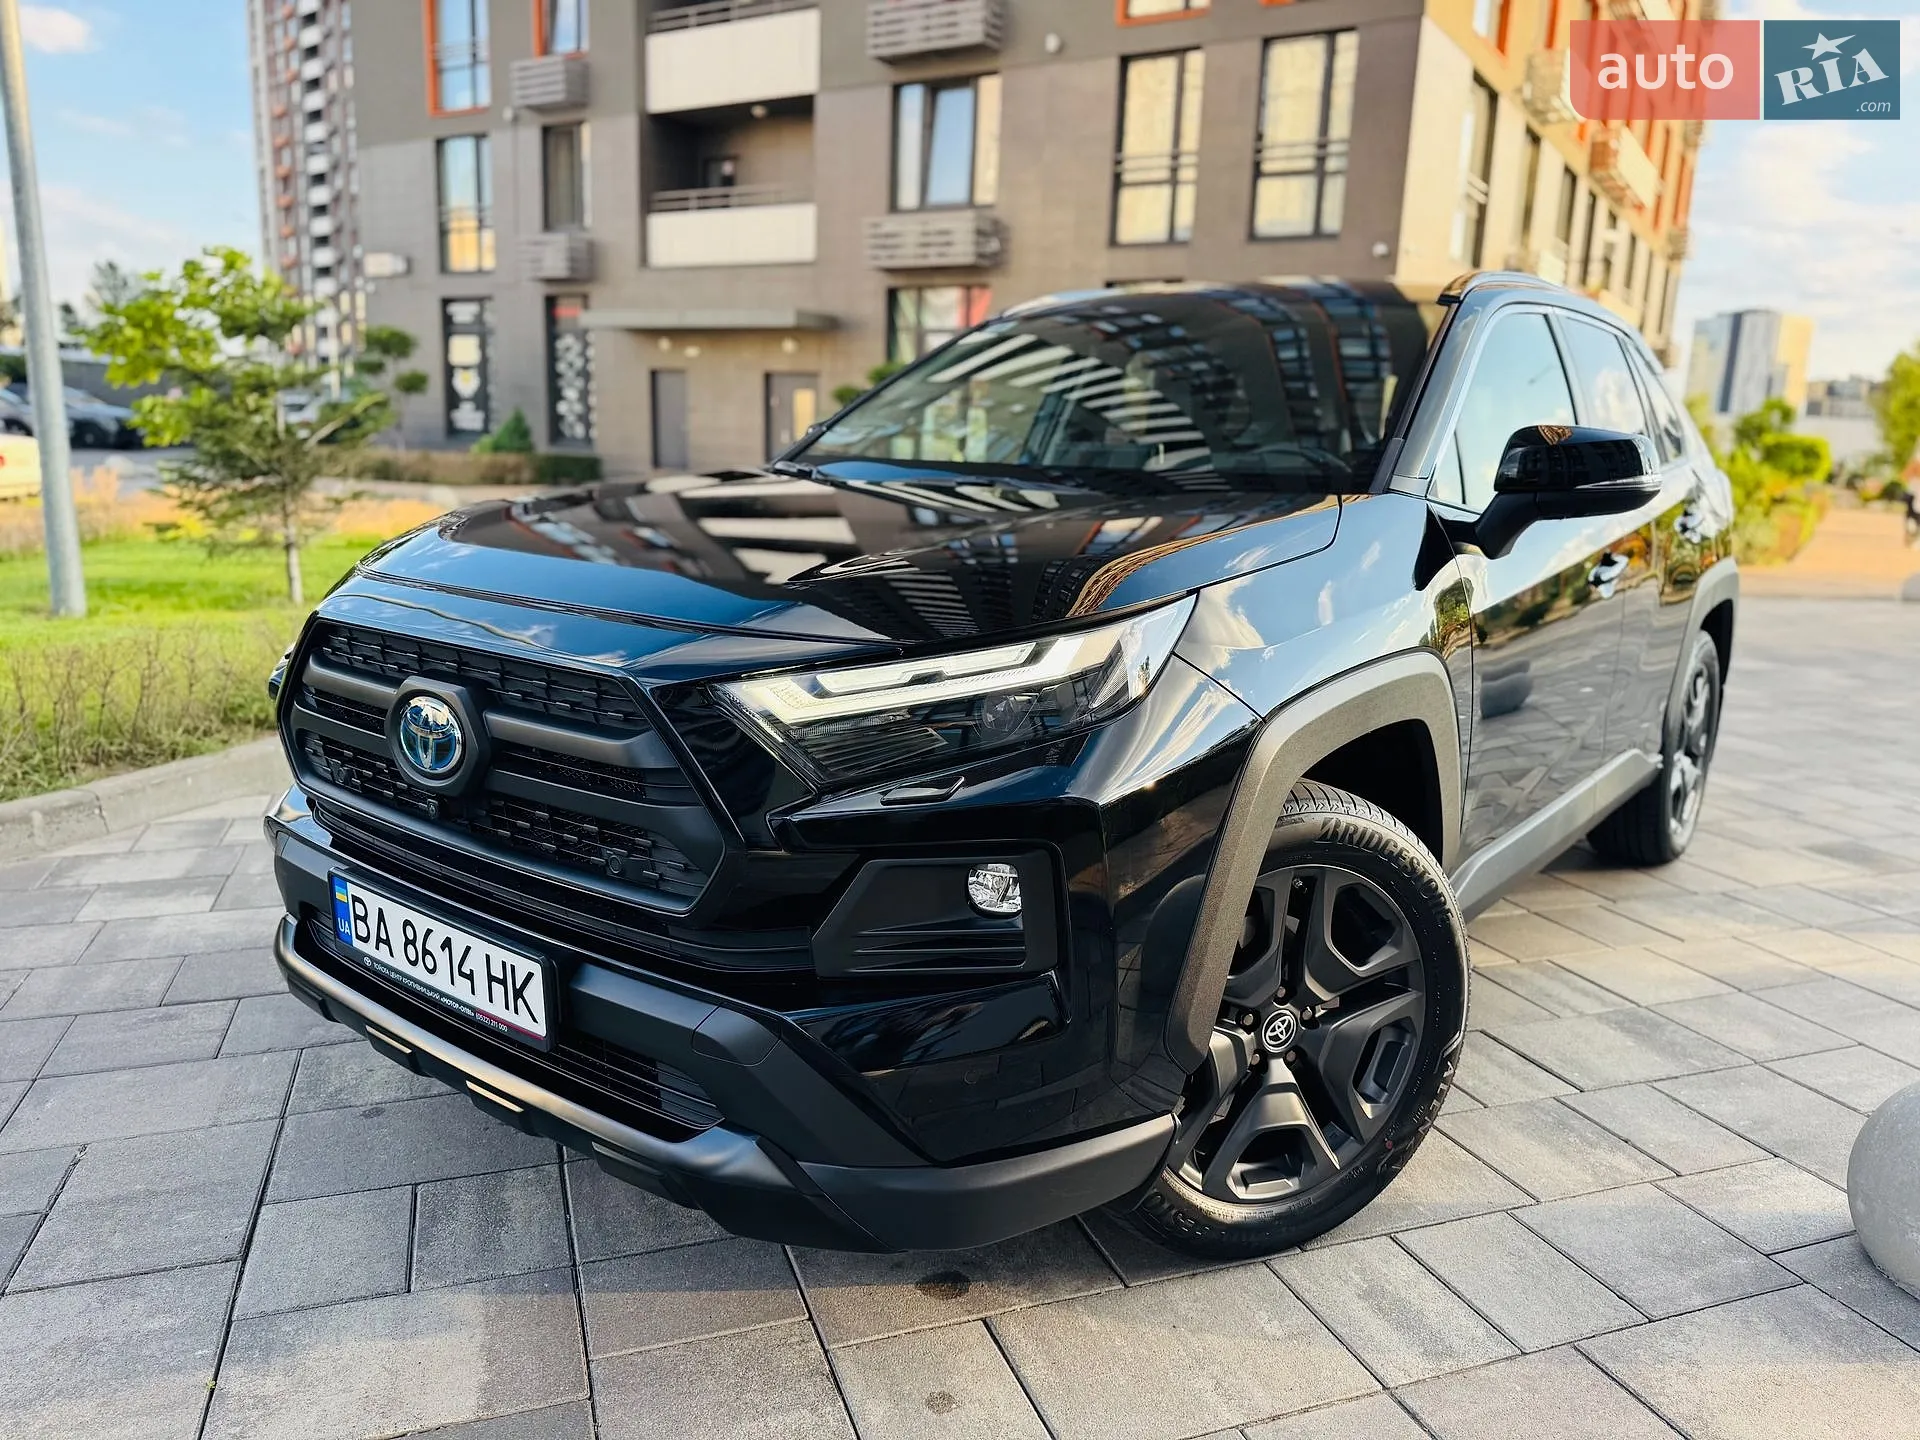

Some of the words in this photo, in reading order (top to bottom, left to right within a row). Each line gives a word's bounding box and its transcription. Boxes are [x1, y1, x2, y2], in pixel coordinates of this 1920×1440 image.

[1317, 816, 1455, 923] BRIDGESTONE
[337, 917, 351, 936] UA
[350, 893, 395, 959] BA
[402, 918, 476, 997] 8614
[485, 953, 539, 1025] HK
